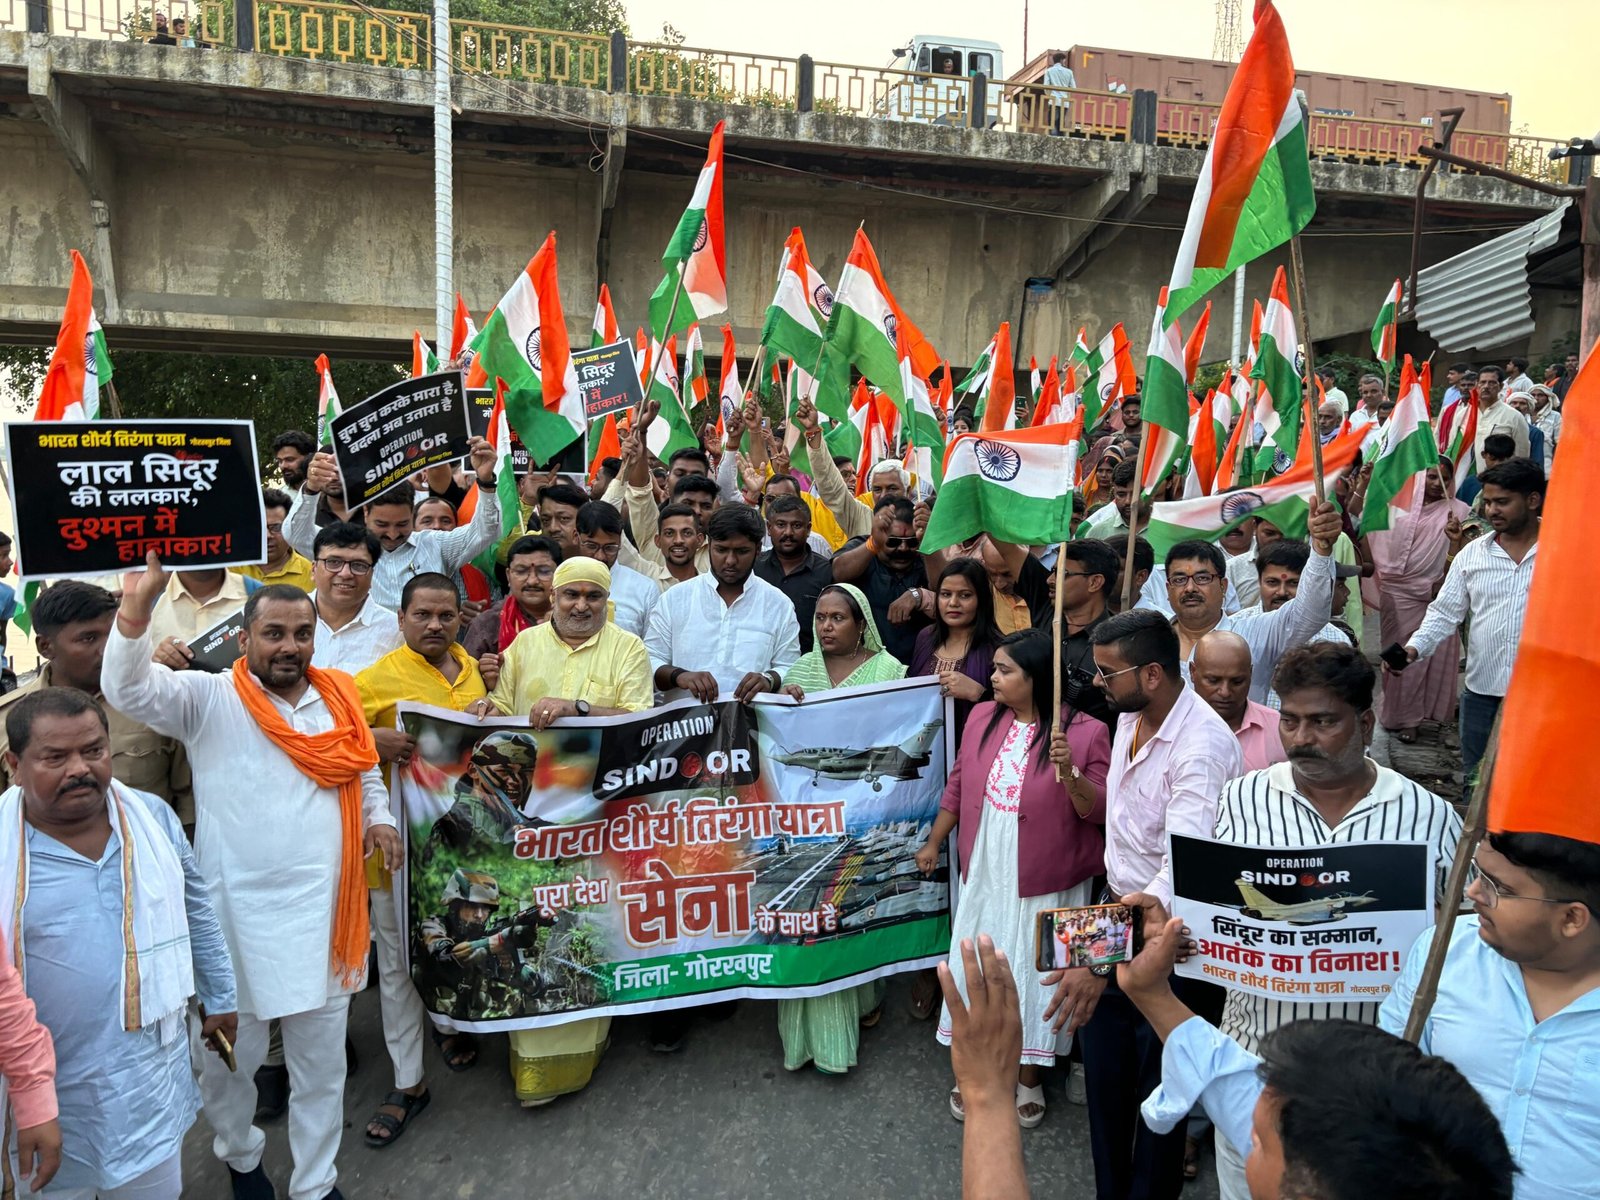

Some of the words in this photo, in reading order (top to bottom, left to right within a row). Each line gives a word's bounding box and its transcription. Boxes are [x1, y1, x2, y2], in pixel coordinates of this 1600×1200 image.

[579, 377, 608, 390] लकार,
[337, 422, 358, 443] चुन
[358, 411, 379, 432] चुन
[378, 395, 410, 418] करके
[412, 386, 441, 402] मारा
[347, 427, 381, 454] बदला
[382, 416, 404, 435] अब
[404, 402, 440, 424] उतारा
[441, 397, 452, 412] है
[38, 434, 79, 449] भारत
[81, 430, 112, 448] शौर्य
[113, 430, 153, 448] तिरंगा
[156, 432, 187, 447] यात्रा
[380, 428, 424, 458] OPERATION
[57, 460, 134, 486] लाल
[69, 485, 102, 508] की
[107, 487, 198, 508] ललकार,
[58, 515, 146, 551] दुश्मन
[153, 507, 179, 536] में
[641, 715, 715, 747] OPERATION
[514, 819, 609, 861] भारत
[609, 799, 681, 851] शौर्य
[681, 796, 774, 846] तिरंगा
[773, 801, 846, 838] यात्रा
[1266, 857, 1324, 869] OPERATION
[533, 882, 571, 918] पूरा
[571, 875, 609, 905] देश
[616, 858, 757, 949] सेना
[755, 904, 777, 934] के
[776, 910, 820, 935] साथ
[821, 901, 838, 932] है
[1211, 915, 1265, 947] सिंदूर
[1267, 929, 1297, 946] का
[1301, 926, 1383, 946] सम्मान,
[684, 953, 774, 981] गोरखपुर
[1198, 938, 1265, 968] आतंक
[1269, 953, 1304, 974] का
[1202, 963, 1237, 981] भारत
[1240, 970, 1268, 990] शौर्य
[1270, 976, 1311, 994] तिरंगा
[1313, 981, 1346, 994] यात्रा
